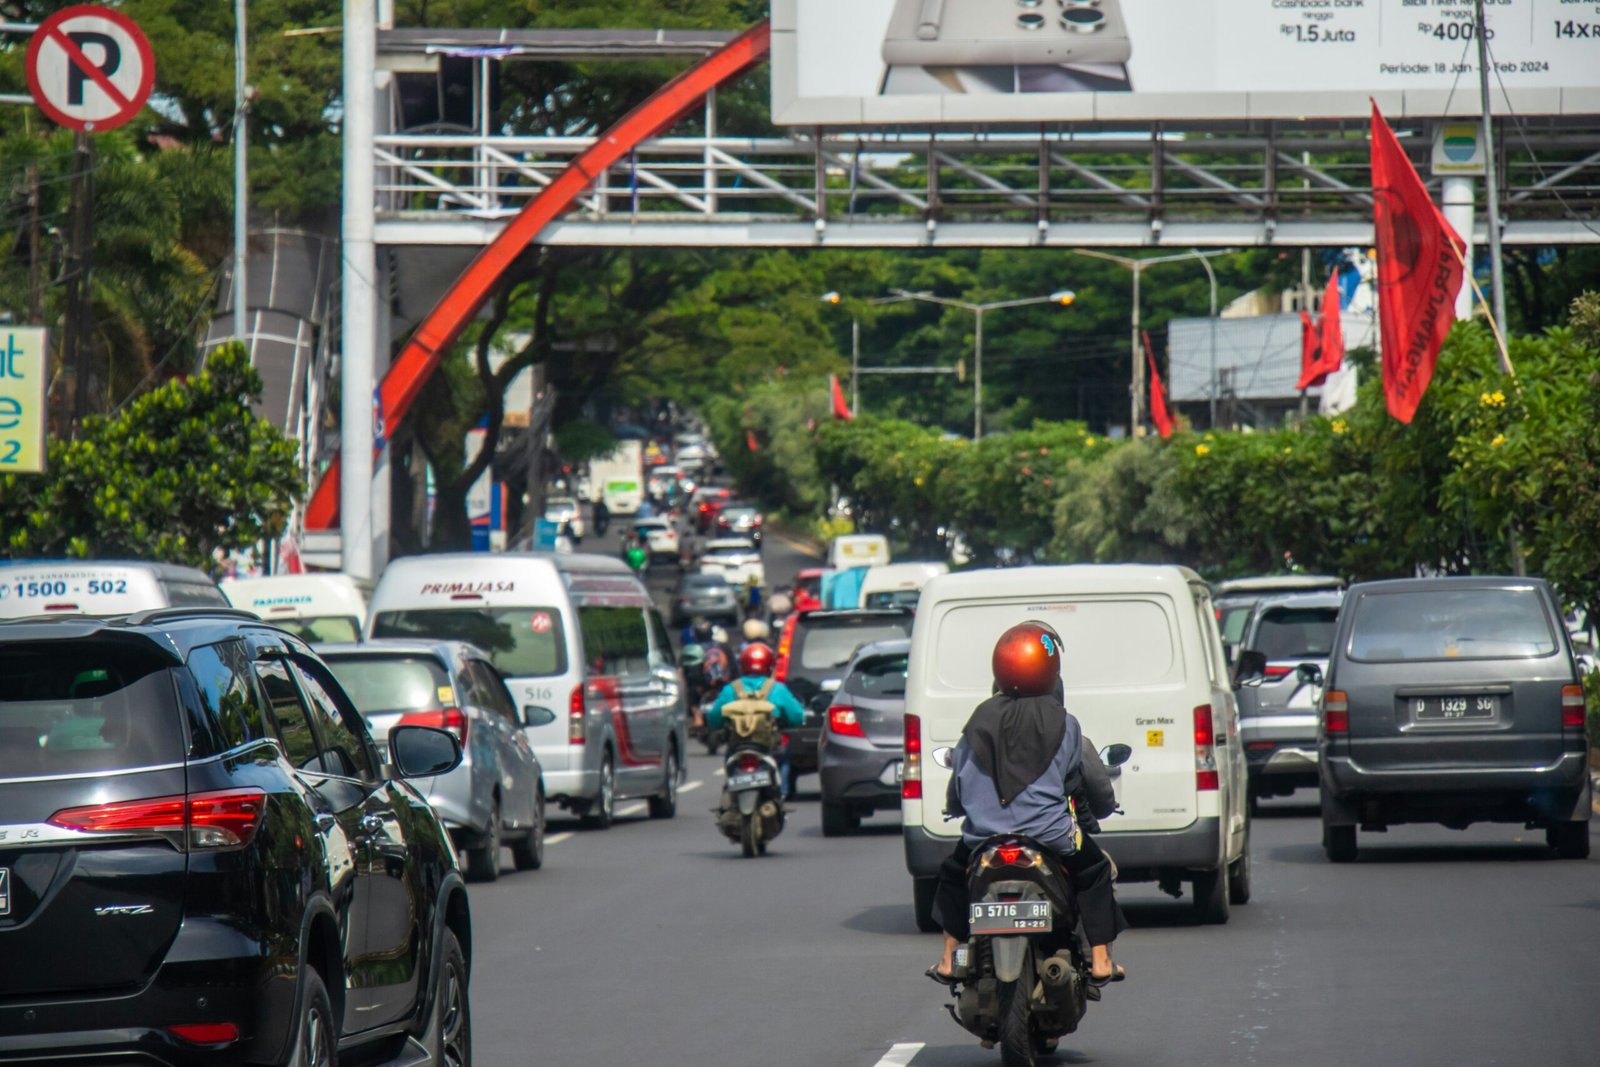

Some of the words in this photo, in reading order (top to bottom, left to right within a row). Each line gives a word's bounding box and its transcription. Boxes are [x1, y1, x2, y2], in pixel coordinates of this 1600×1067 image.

[1302, 11, 1334, 21] hingga
[1441, 9, 1473, 19] hingga
[1321, 29, 1356, 42] Juta
[67, 32, 121, 105] P
[1379, 62, 1431, 74] Periode:
[1435, 63, 1445, 72] 18
[1450, 62, 1472, 73] Jan
[1493, 61, 1517, 72] Feb
[1520, 61, 1549, 72] 2024
[14, 581, 66, 598] 1500
[87, 580, 127, 594] 502
[420, 581, 515, 594] PRIMAJASA
[524, 687, 552, 700] 516
[1416, 698, 1425, 712] D
[1441, 697, 1467, 712] 1329
[1136, 717, 1156, 726] Gran
[1157, 716, 1174, 725] Max
[94, 904, 154, 916] VRZ
[974, 906, 983, 917] D
[987, 905, 1017, 917] 5716
[1014, 920, 1046, 928] 12-25
